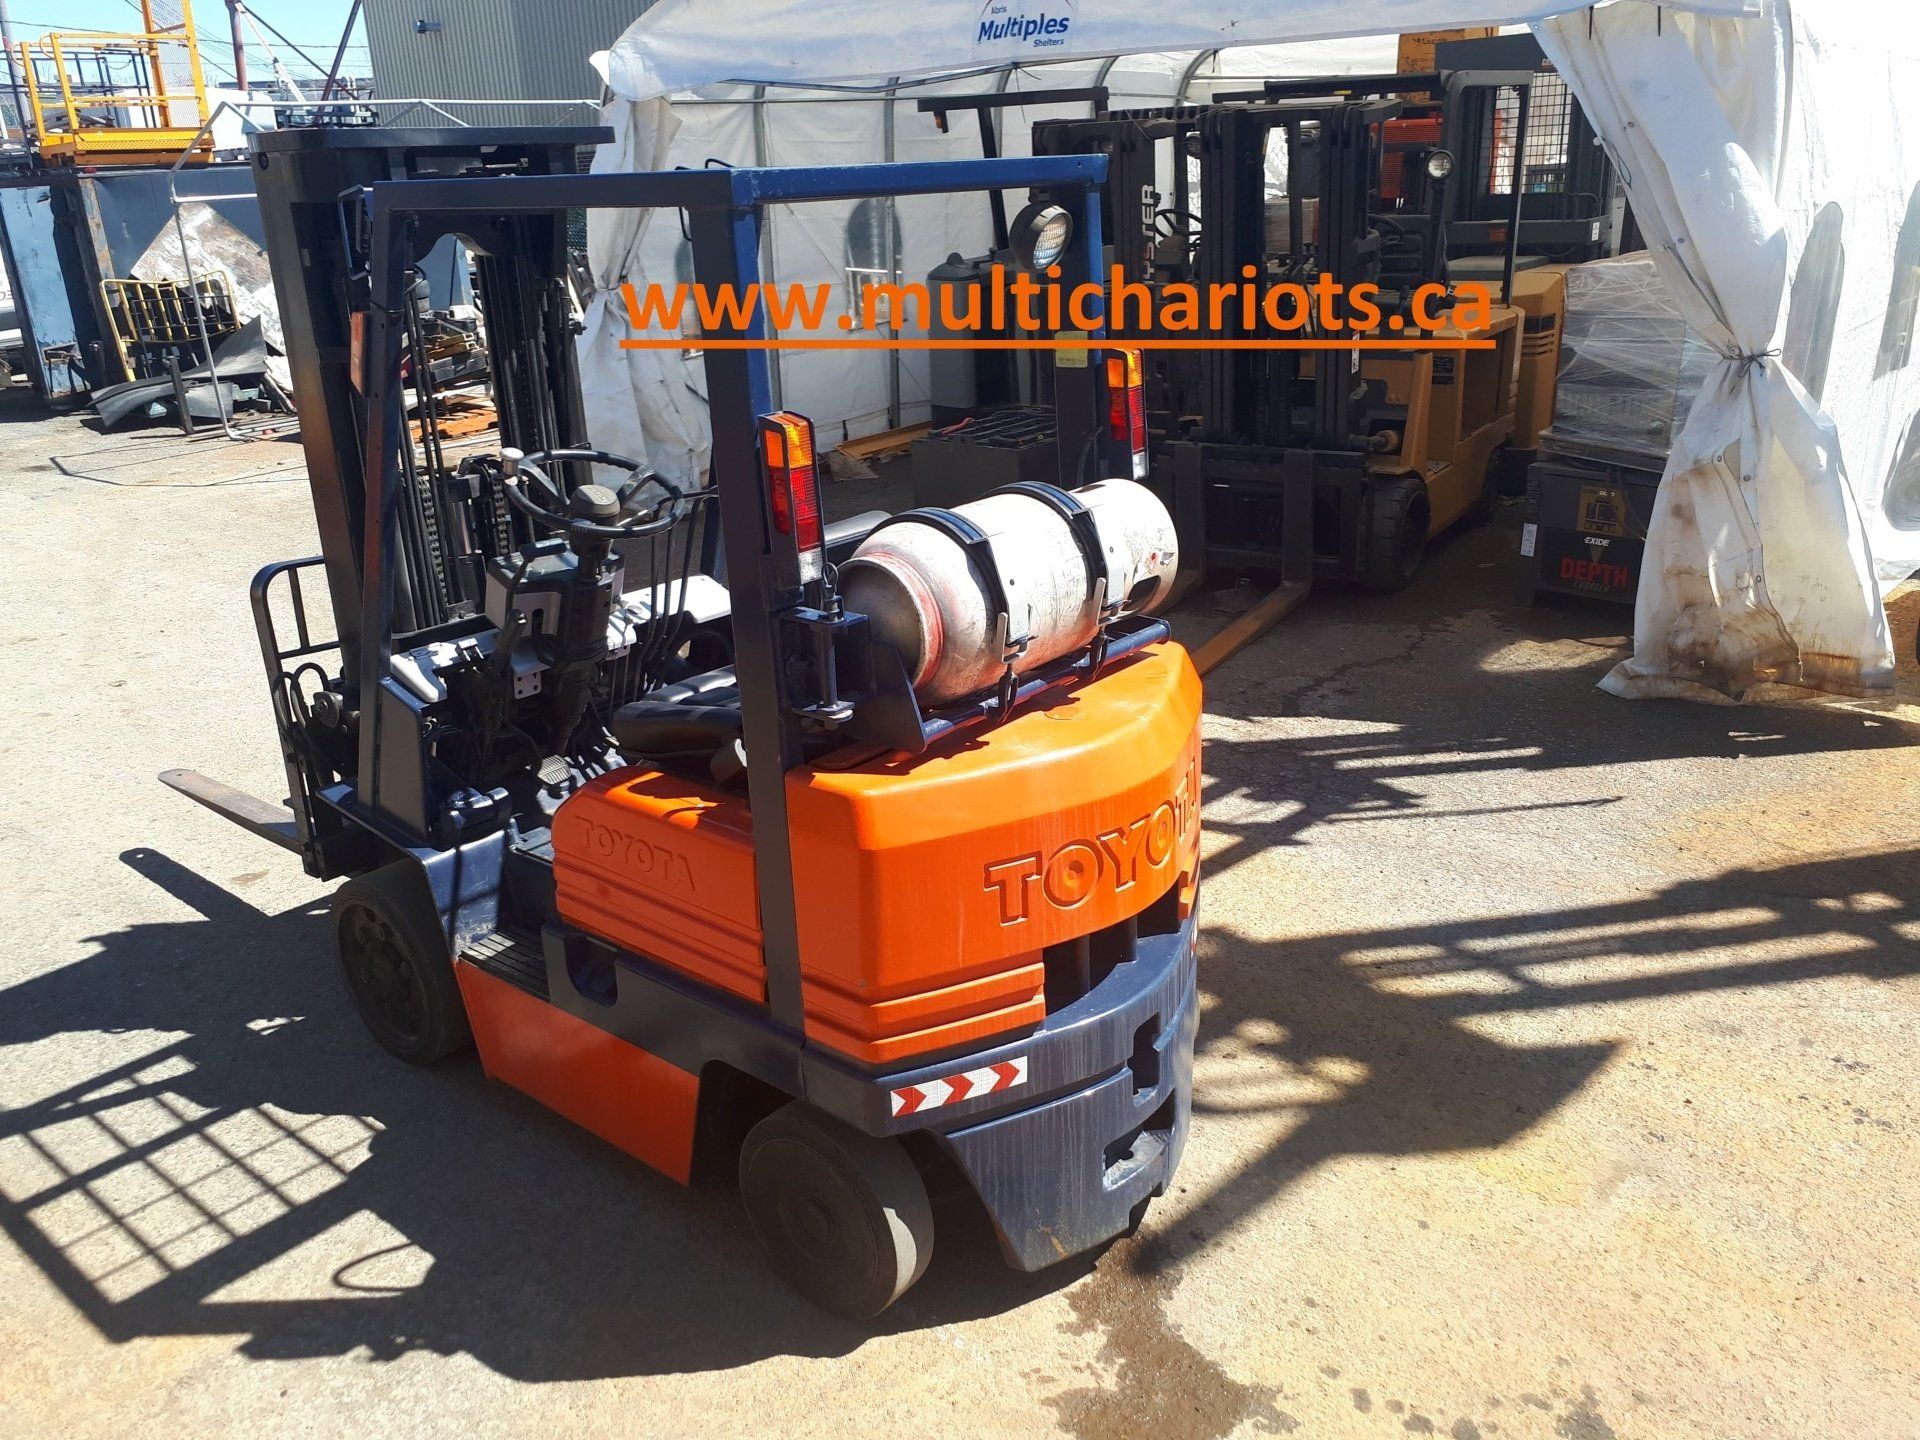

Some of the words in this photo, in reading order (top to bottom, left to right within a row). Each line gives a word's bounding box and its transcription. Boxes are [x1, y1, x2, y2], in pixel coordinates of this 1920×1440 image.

[977, 13, 1069, 41] Multiples
[1033, 38, 1064, 47] Shelters
[1141, 184, 1155, 284] YSTER
[1584, 536, 1610, 547] EXIDE
[1559, 556, 1629, 587] DEPTH
[574, 815, 696, 892] TOYOTA
